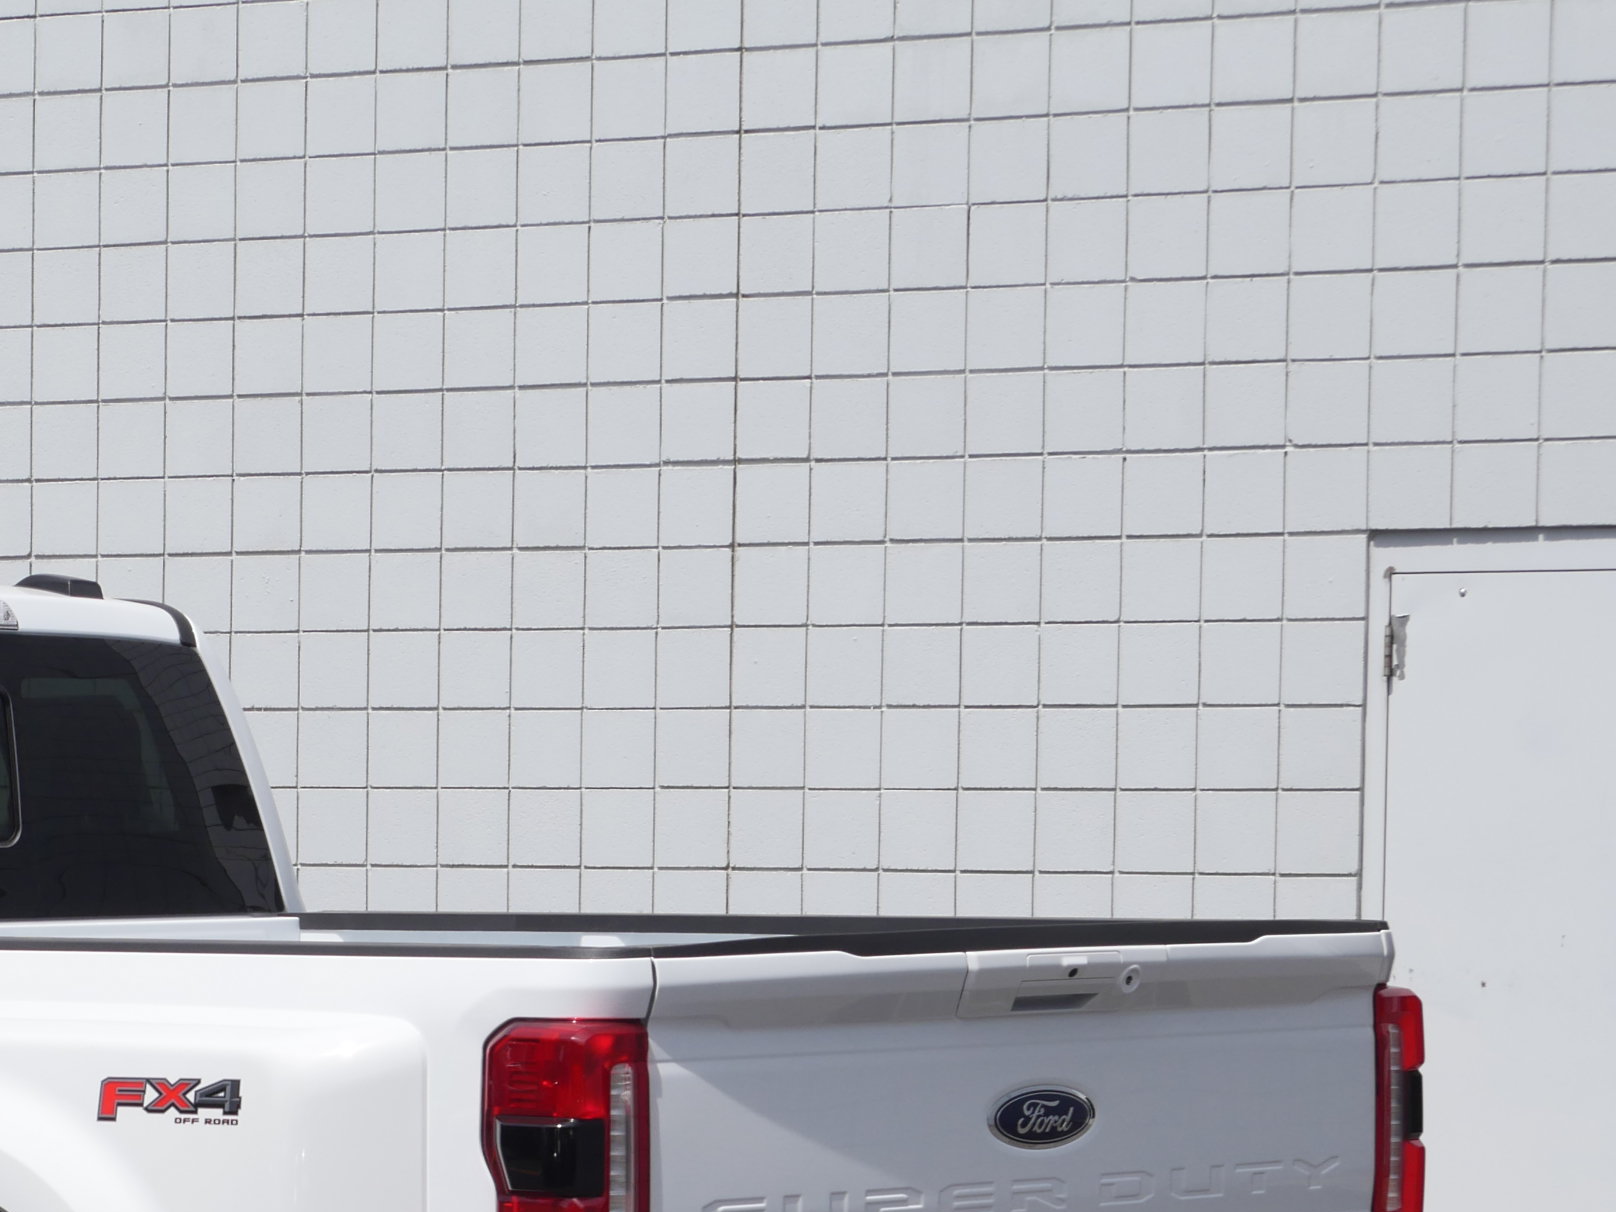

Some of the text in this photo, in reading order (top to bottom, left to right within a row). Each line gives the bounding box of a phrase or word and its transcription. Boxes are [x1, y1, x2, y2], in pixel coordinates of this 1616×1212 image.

[97, 1077, 241, 1121] FX4
[1017, 1100, 1074, 1134] Ford
[174, 1117, 239, 1126] OFF ROAD
[1098, 1155, 1340, 1207] DUTY
